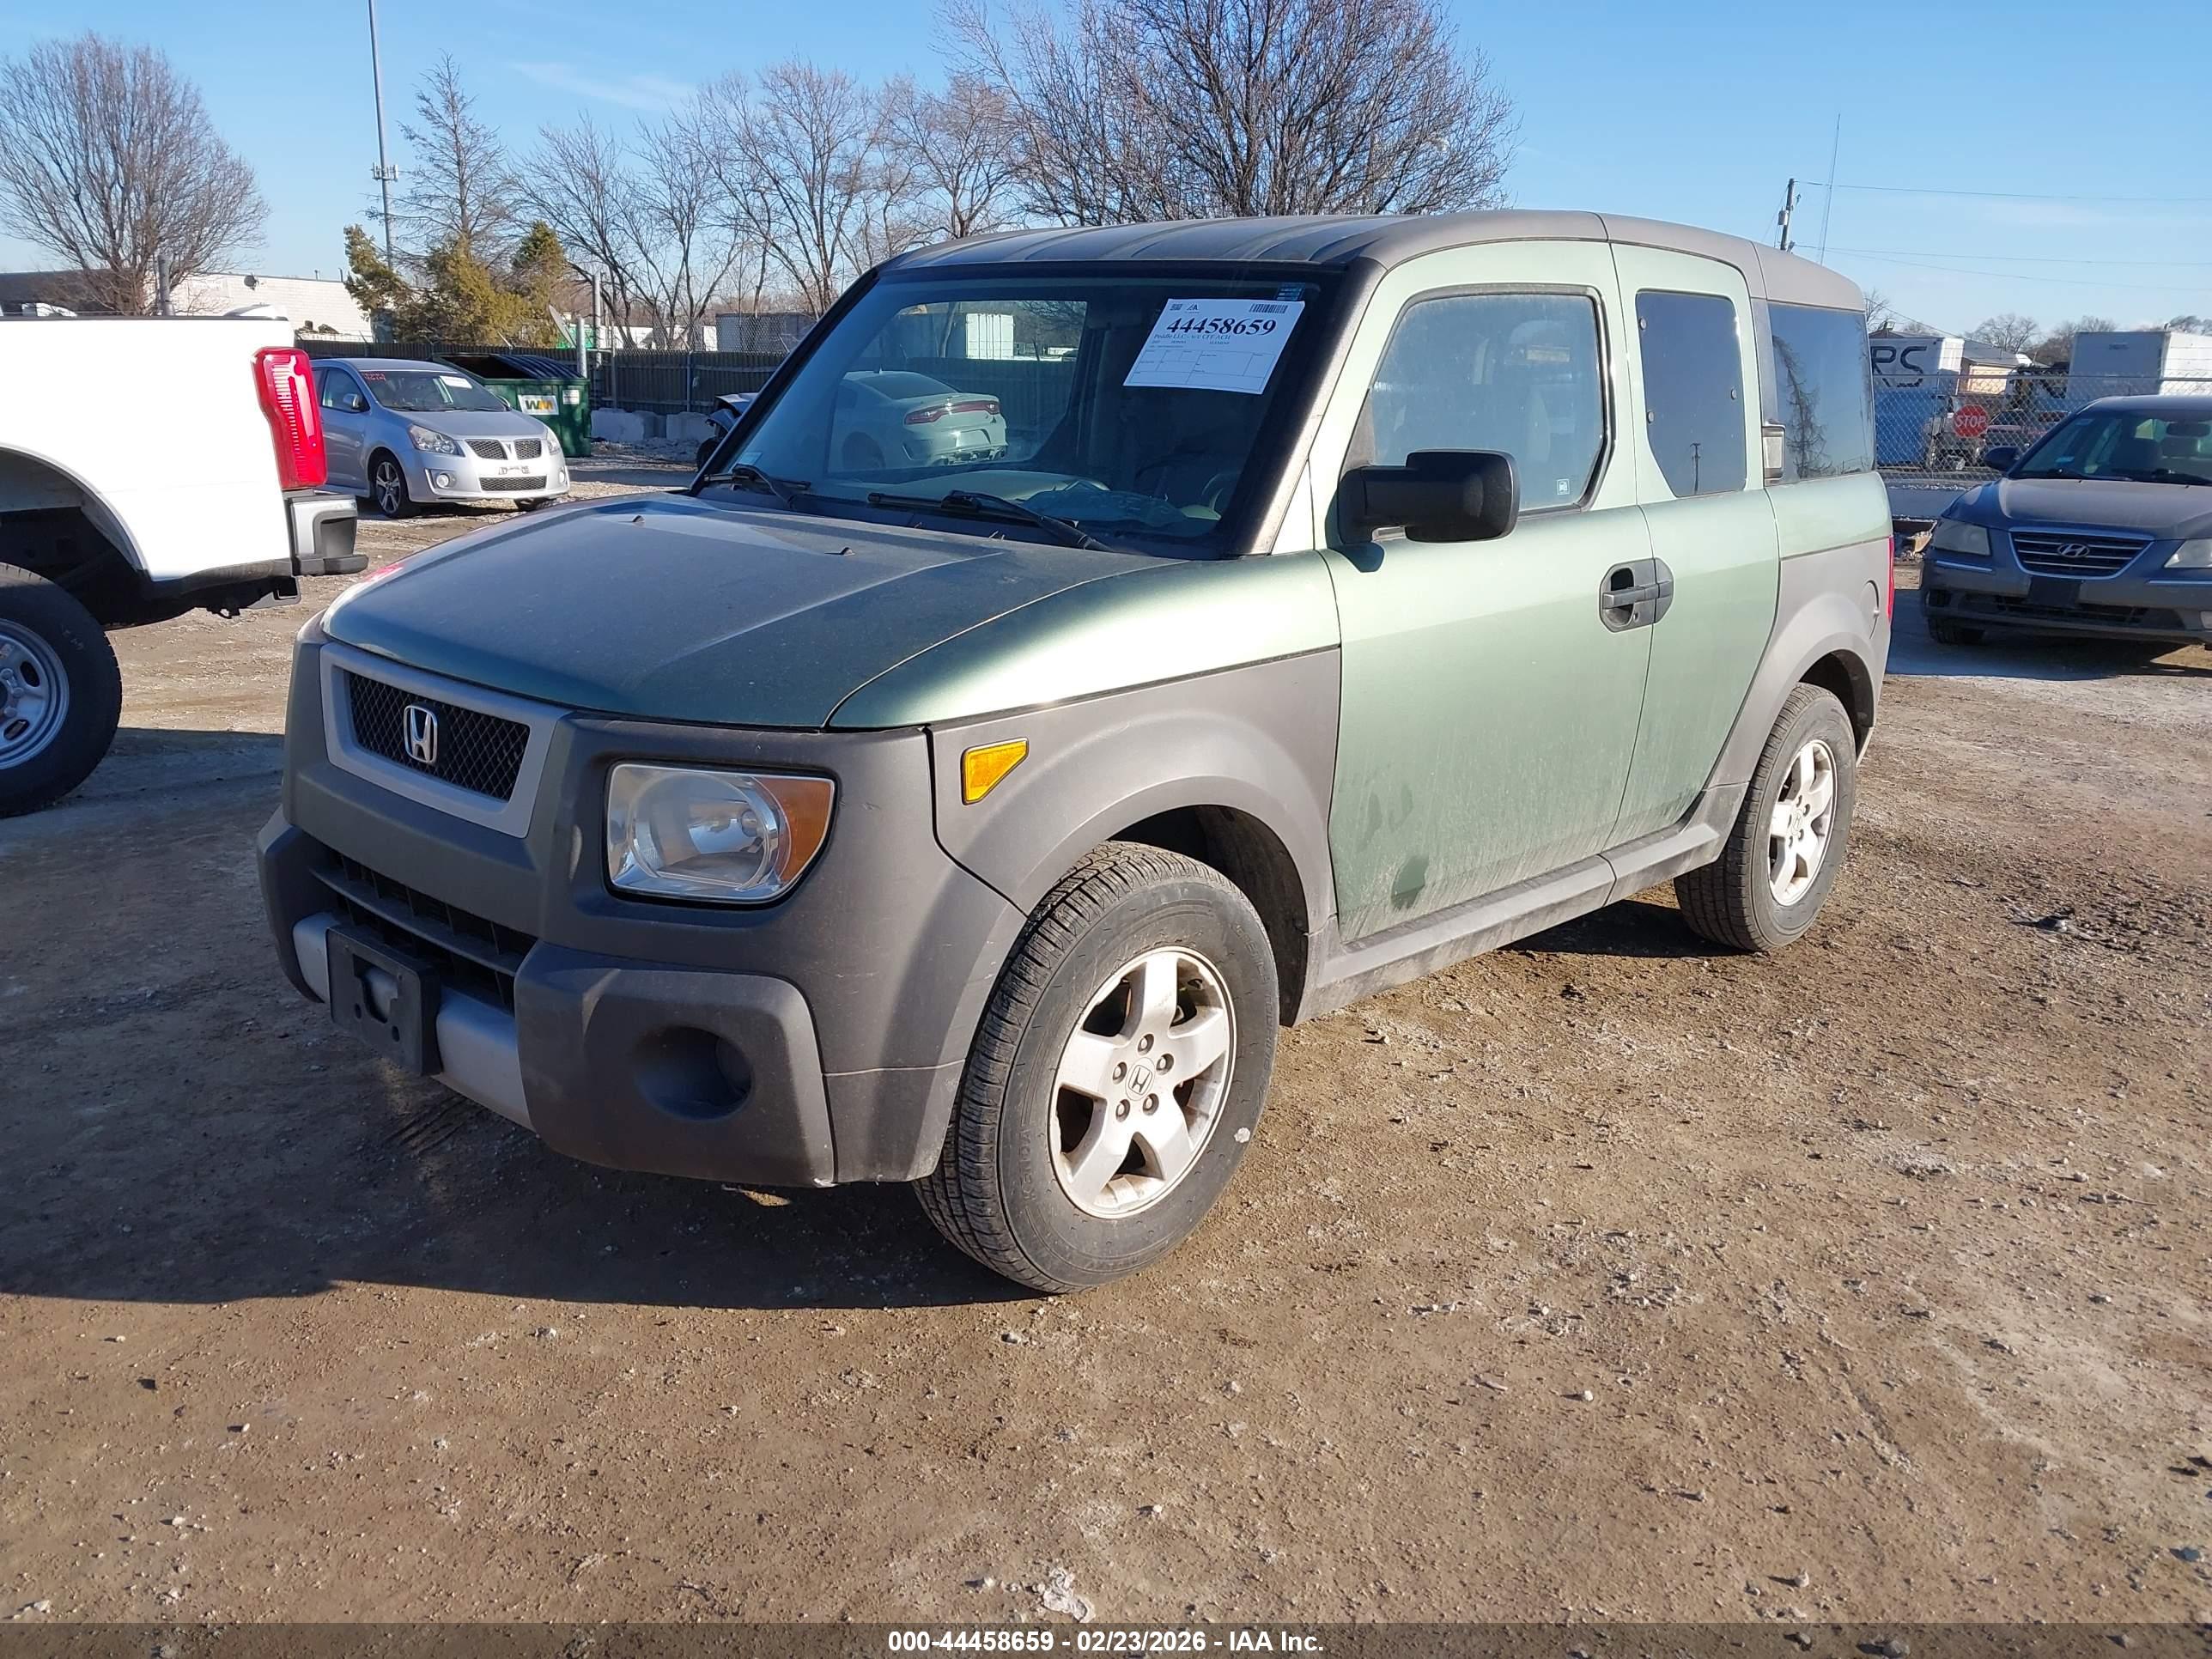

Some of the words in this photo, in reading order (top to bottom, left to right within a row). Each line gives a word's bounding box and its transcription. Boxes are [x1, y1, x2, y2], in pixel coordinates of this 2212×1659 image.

[1166, 317, 1277, 336] 44458659
[525, 399, 554, 410] WM
[1954, 415, 1987, 428] STOP
